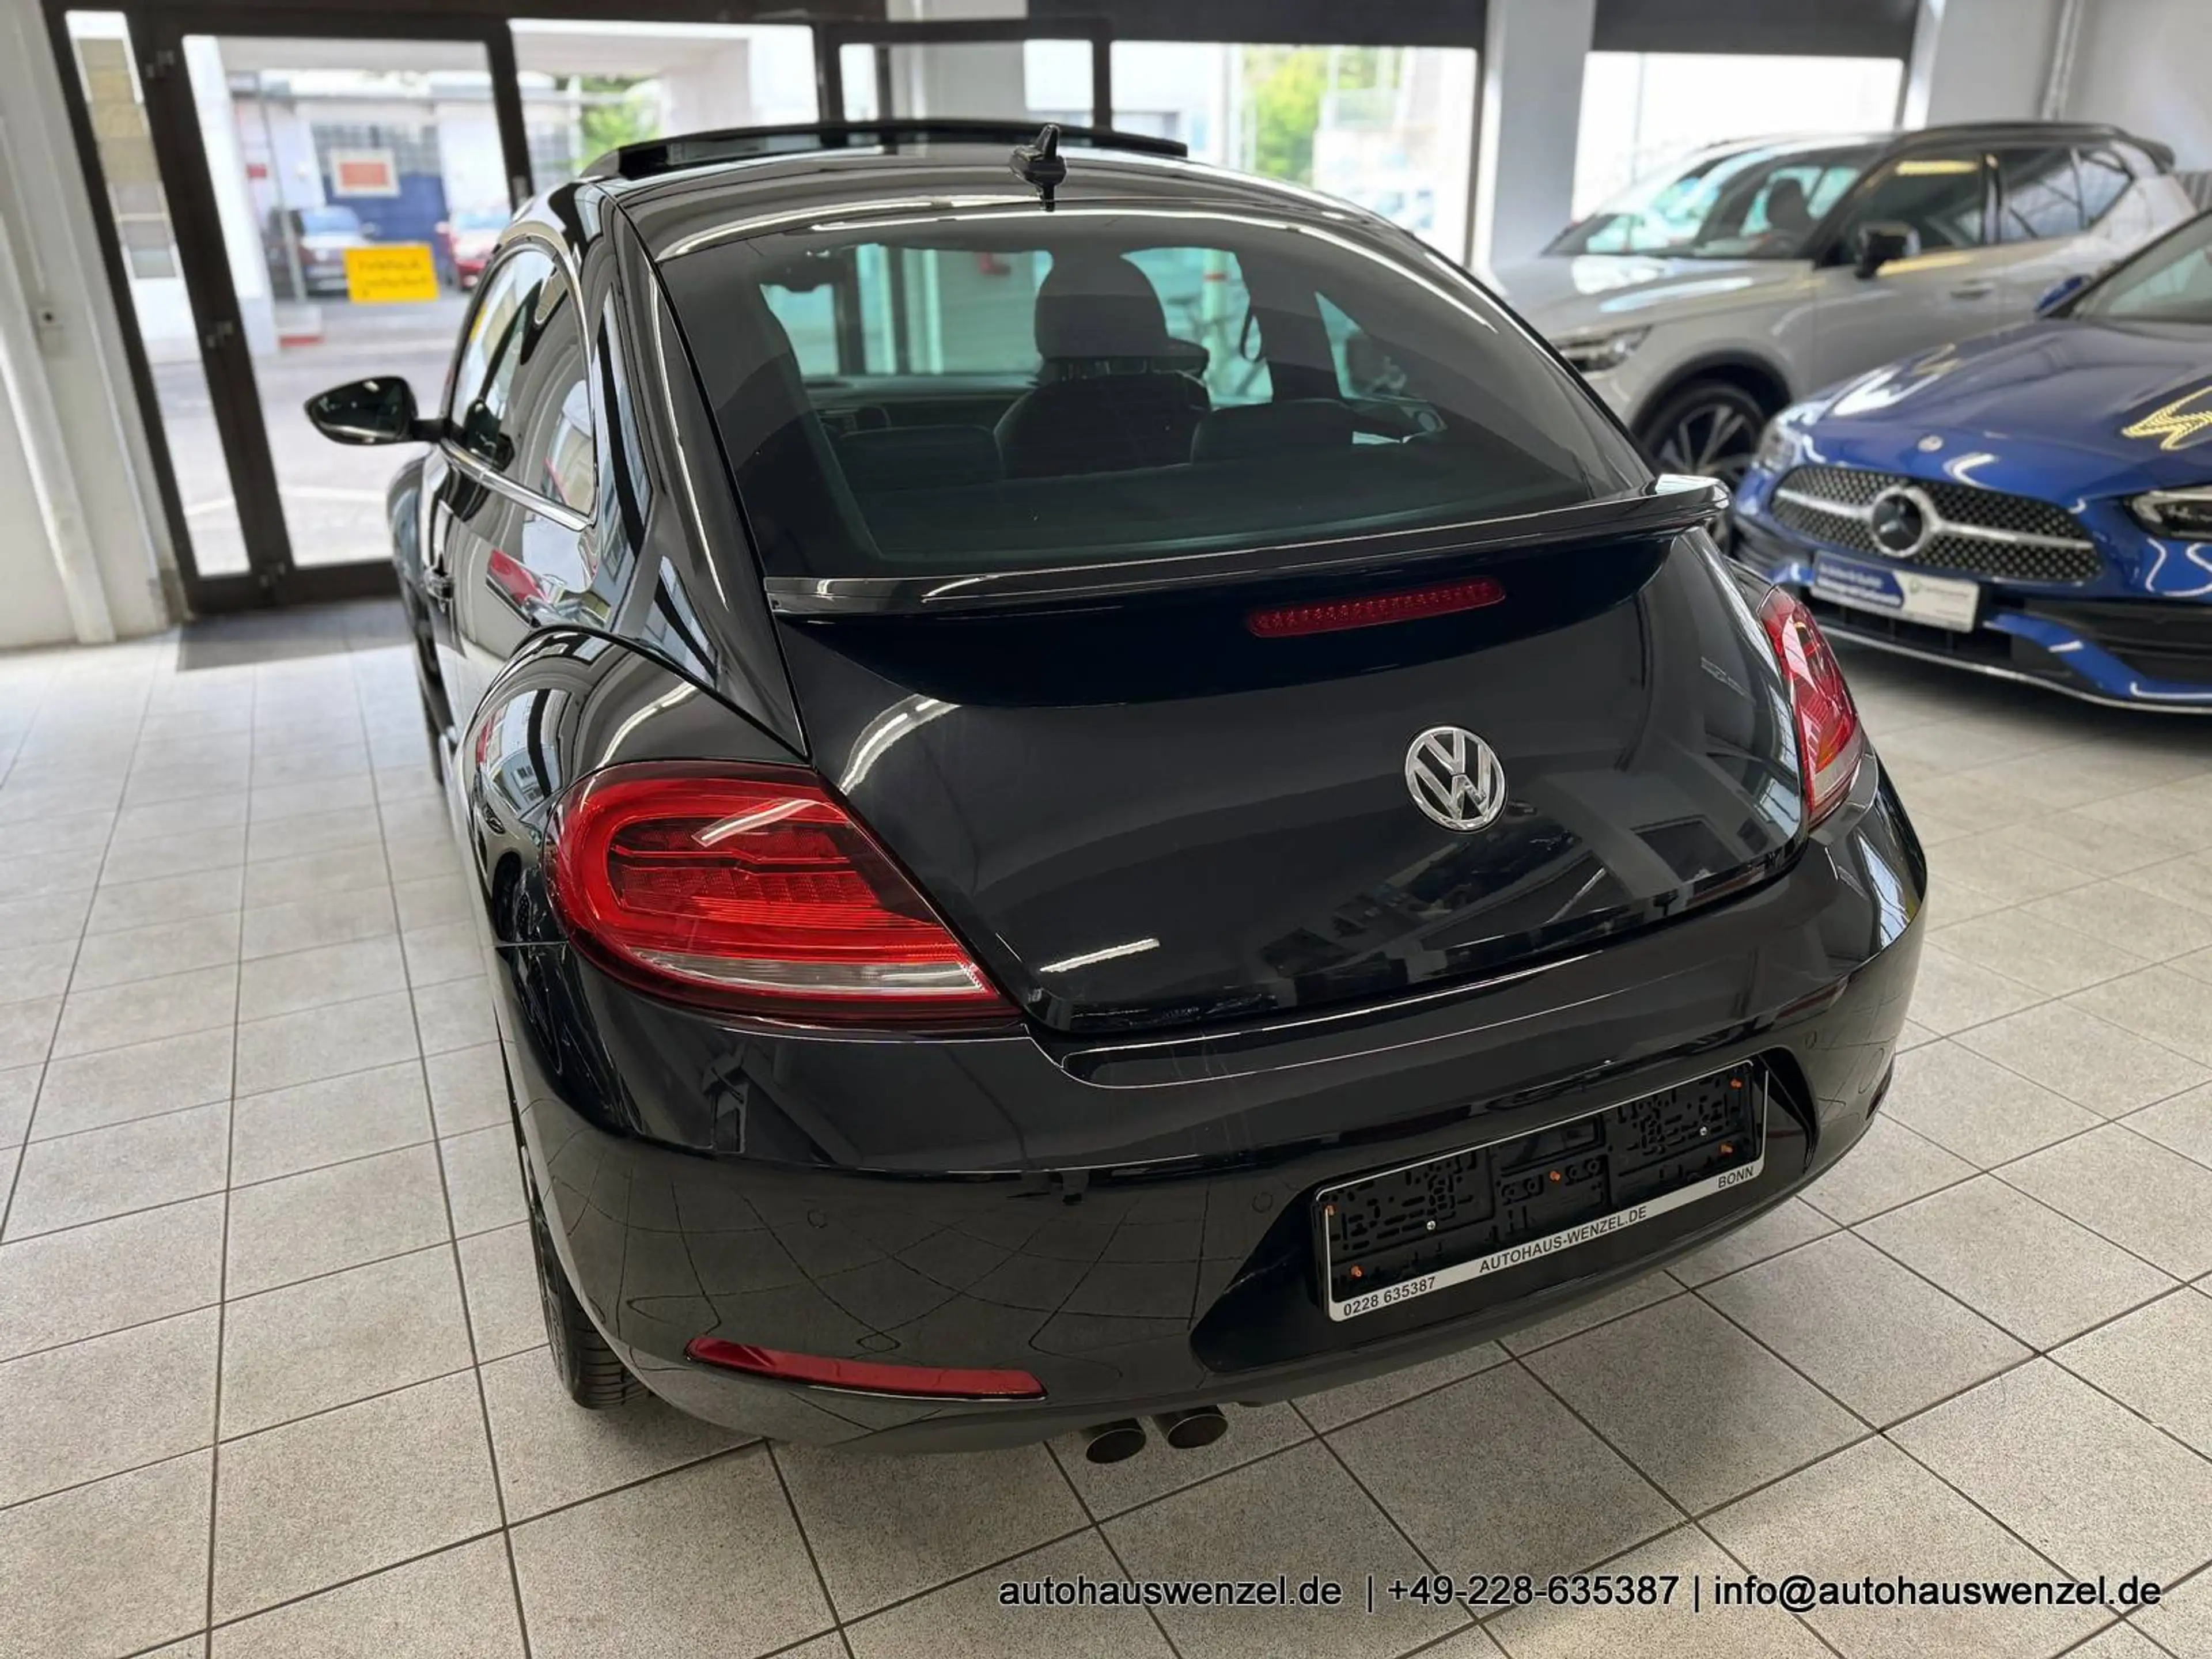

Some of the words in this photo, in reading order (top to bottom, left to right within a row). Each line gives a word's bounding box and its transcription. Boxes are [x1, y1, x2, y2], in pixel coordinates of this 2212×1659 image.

[1406, 726, 1505, 831] VW
[1343, 1294, 1378, 1316] 0228
[1384, 1277, 1435, 1303] 635387
[1479, 1206, 1646, 1272] AUTOHAUS-WENZEL.DE
[1718, 1166, 1753, 1188] BONN
